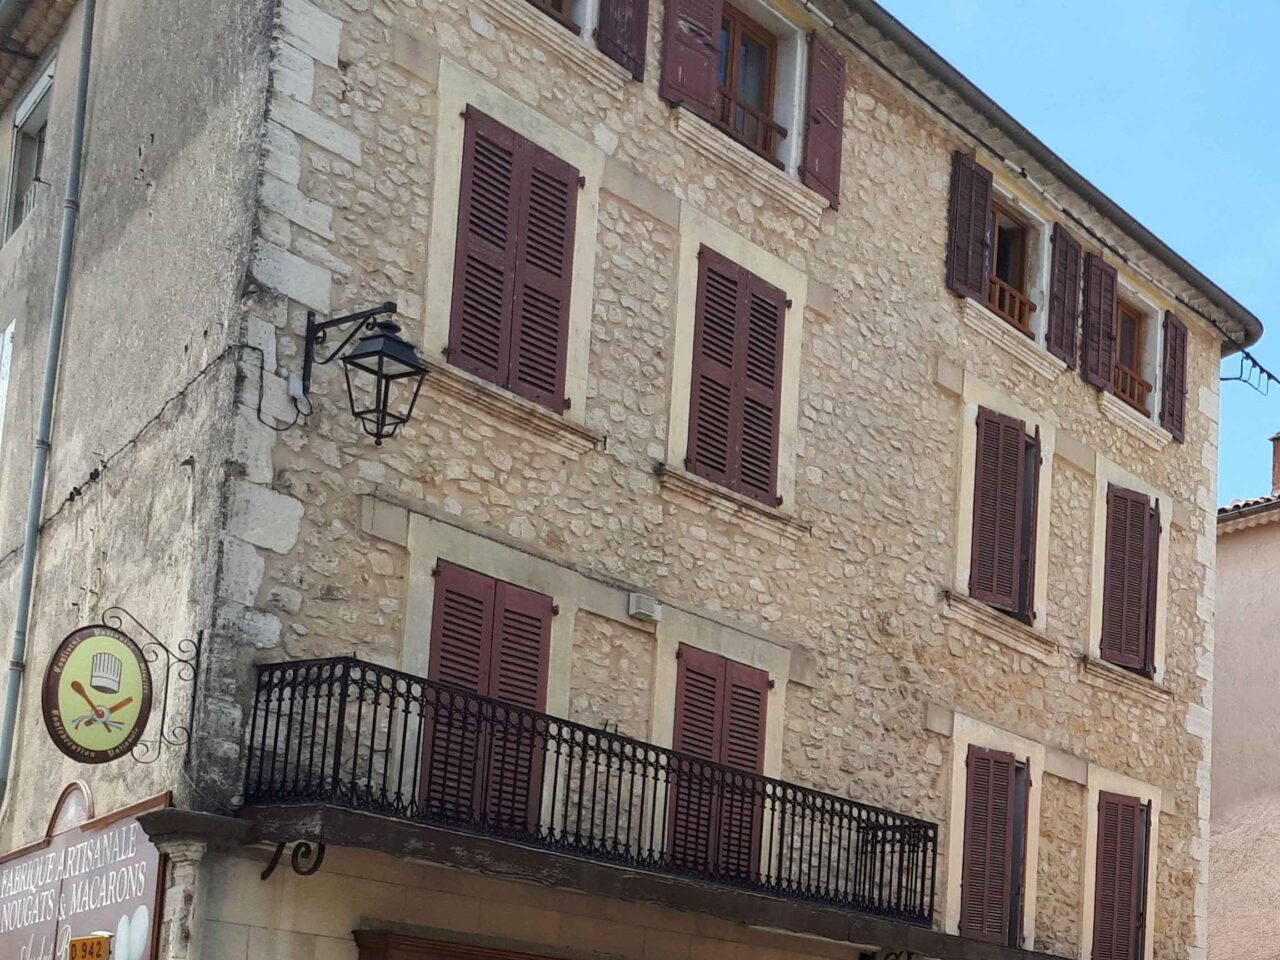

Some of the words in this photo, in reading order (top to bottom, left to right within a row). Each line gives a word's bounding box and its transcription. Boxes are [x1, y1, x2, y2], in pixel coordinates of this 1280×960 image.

[0, 852, 55, 898] FABRIQUE
[55, 823, 138, 881] ARTISANALE
[0, 889, 55, 933] NOUGATS
[57, 893, 66, 921] &
[69, 861, 146, 915] MACARONS
[81, 941, 102, 959] 942
